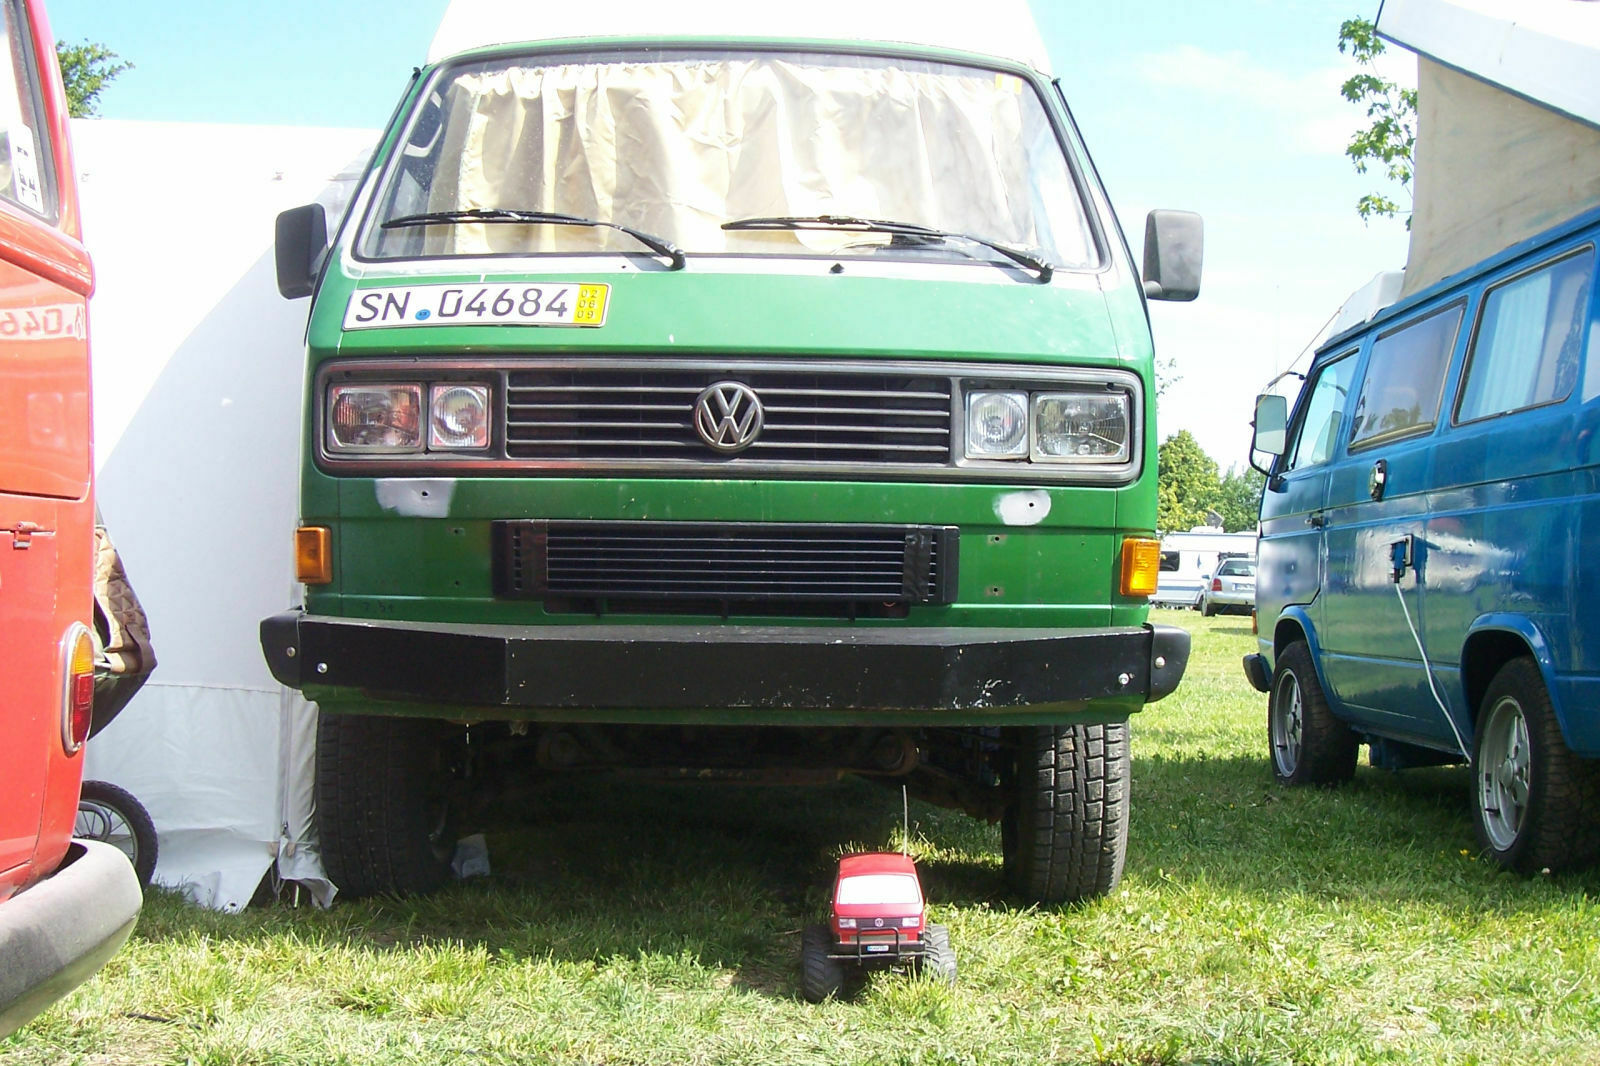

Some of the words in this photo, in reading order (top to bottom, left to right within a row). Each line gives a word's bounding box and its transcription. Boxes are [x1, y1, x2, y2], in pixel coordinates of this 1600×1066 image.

[355, 291, 411, 322] SN
[437, 288, 569, 318] 04684
[694, 381, 764, 451] VW
